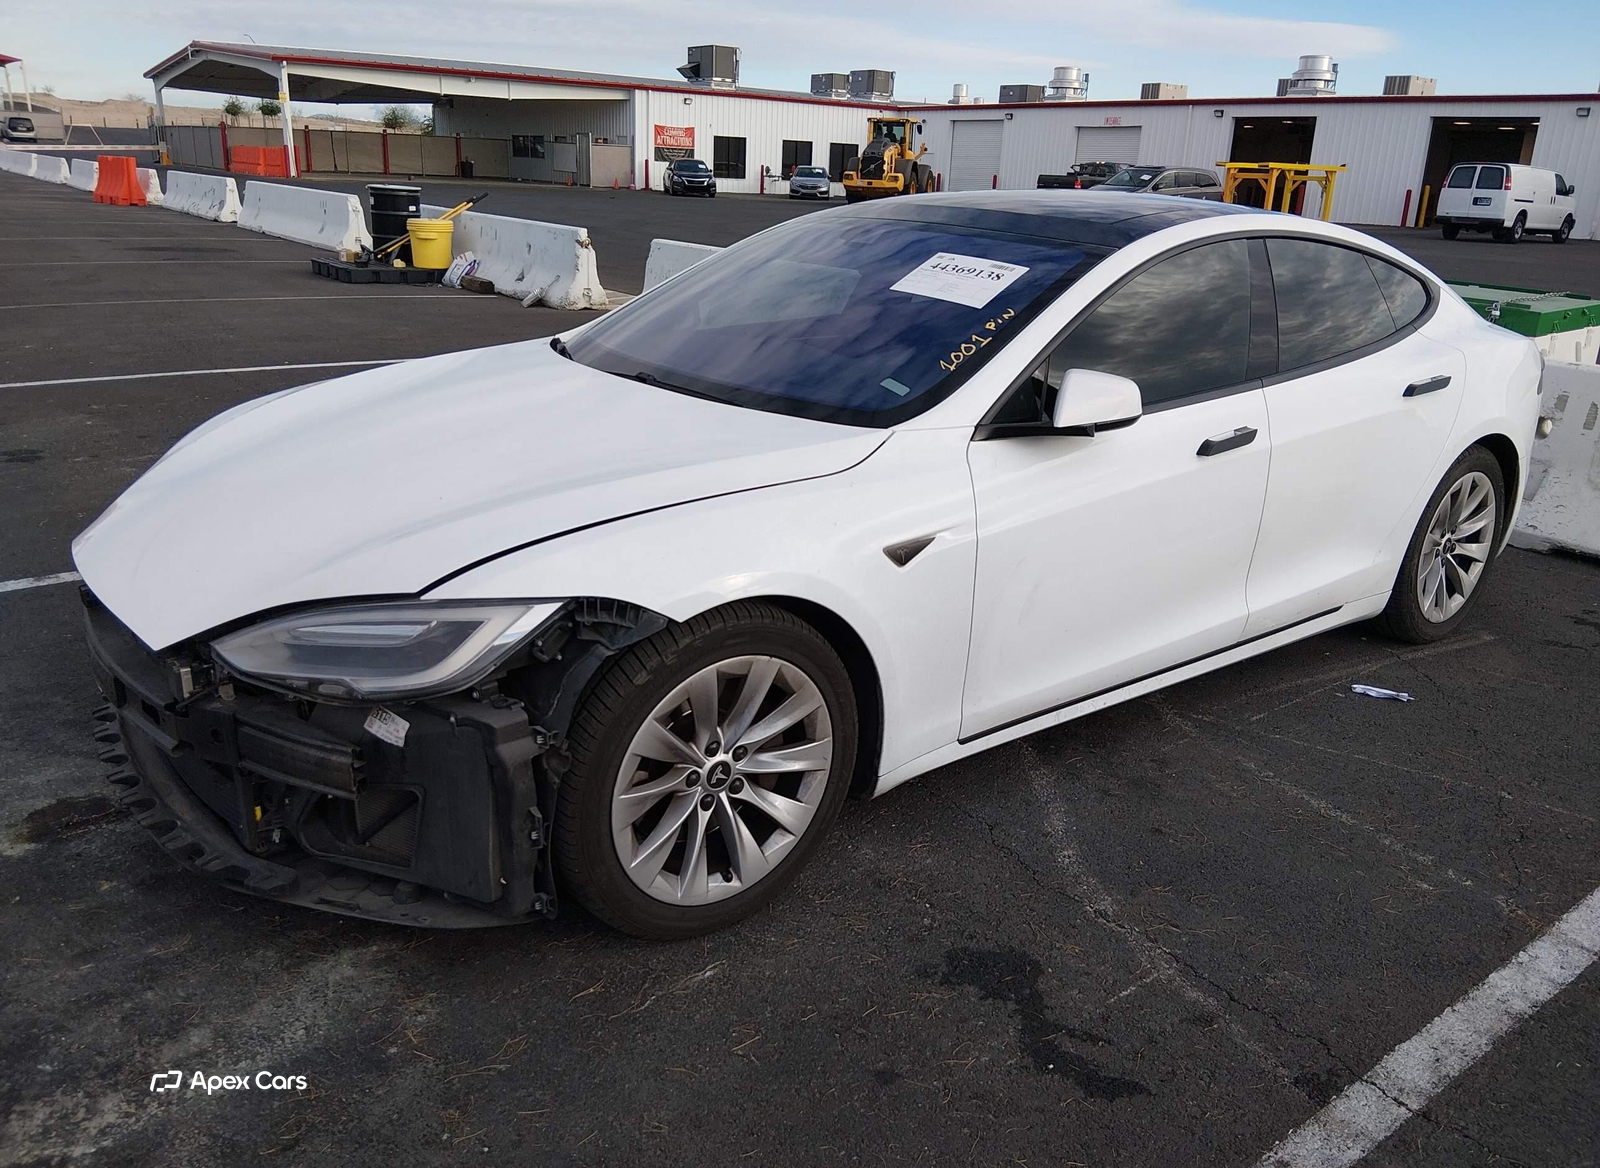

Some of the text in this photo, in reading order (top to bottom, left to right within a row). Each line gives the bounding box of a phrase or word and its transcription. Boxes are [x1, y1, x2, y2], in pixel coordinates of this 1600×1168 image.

[656, 136, 693, 146] ATTRACTIONS
[930, 262, 1005, 282] 44369138
[939, 334, 993, 371] 1001
